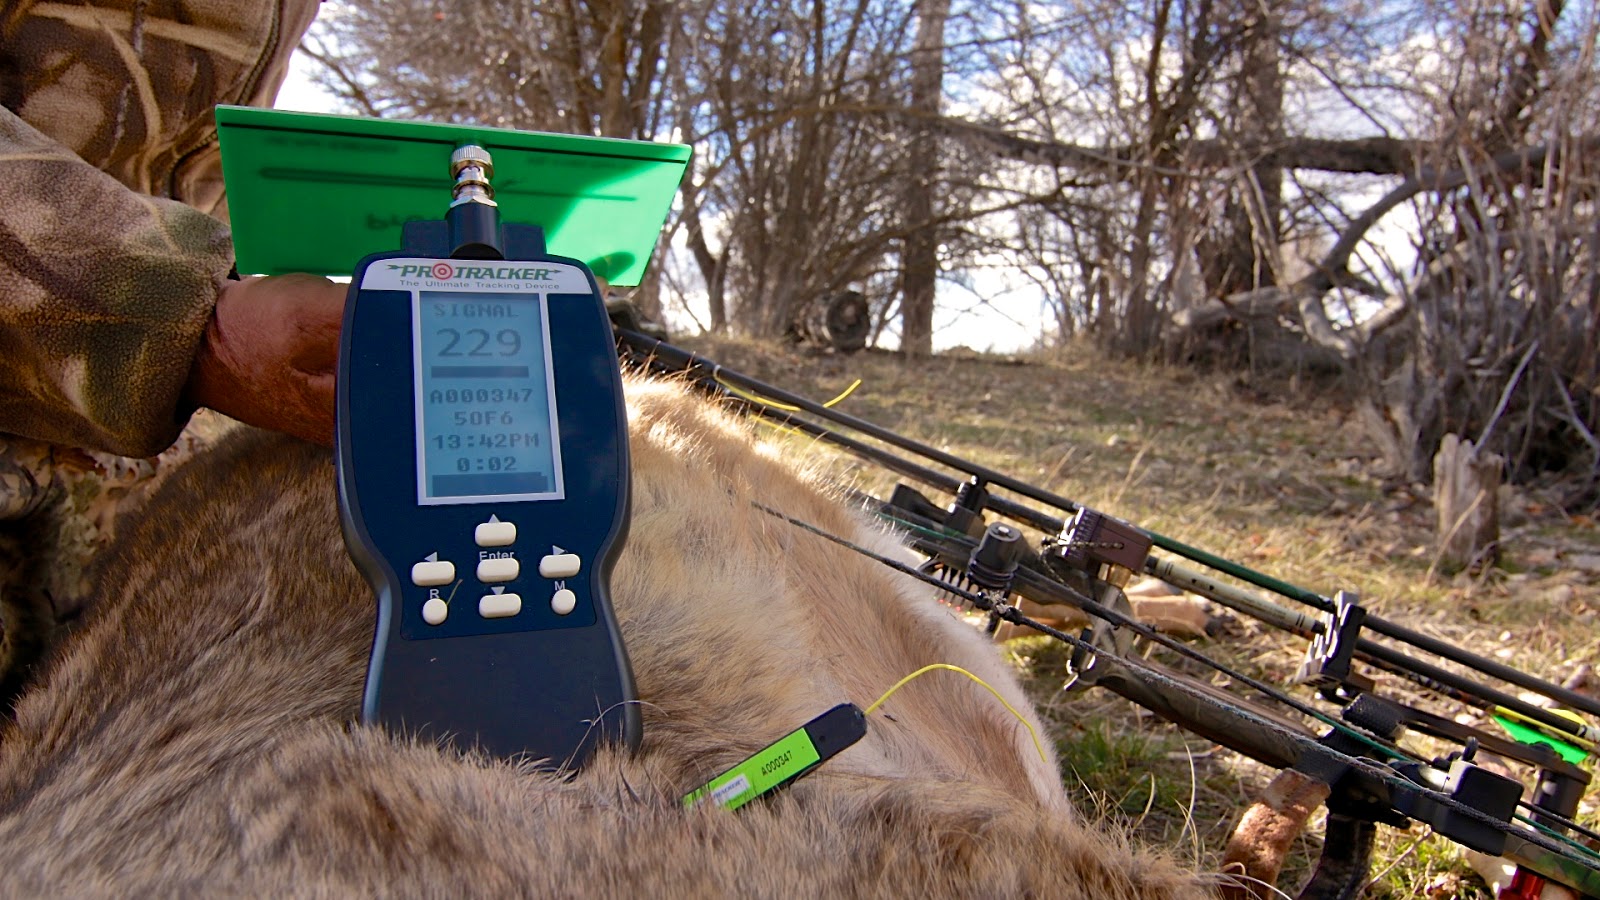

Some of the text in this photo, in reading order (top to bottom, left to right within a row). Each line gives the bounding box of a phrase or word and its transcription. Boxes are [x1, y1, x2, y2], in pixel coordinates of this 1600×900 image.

[426, 280, 469, 288] Ultimate
[475, 281, 520, 290] Tracking
[434, 303, 519, 318] SIGNAL
[436, 328, 521, 357] 229
[430, 388, 533, 404] A000347
[432, 432, 540, 449] 13:42PM
[457, 456, 517, 472] 0:02
[479, 551, 515, 560] Enter
[554, 581, 566, 591] M
[429, 589, 440, 599] R
[761, 750, 793, 776] A000347
